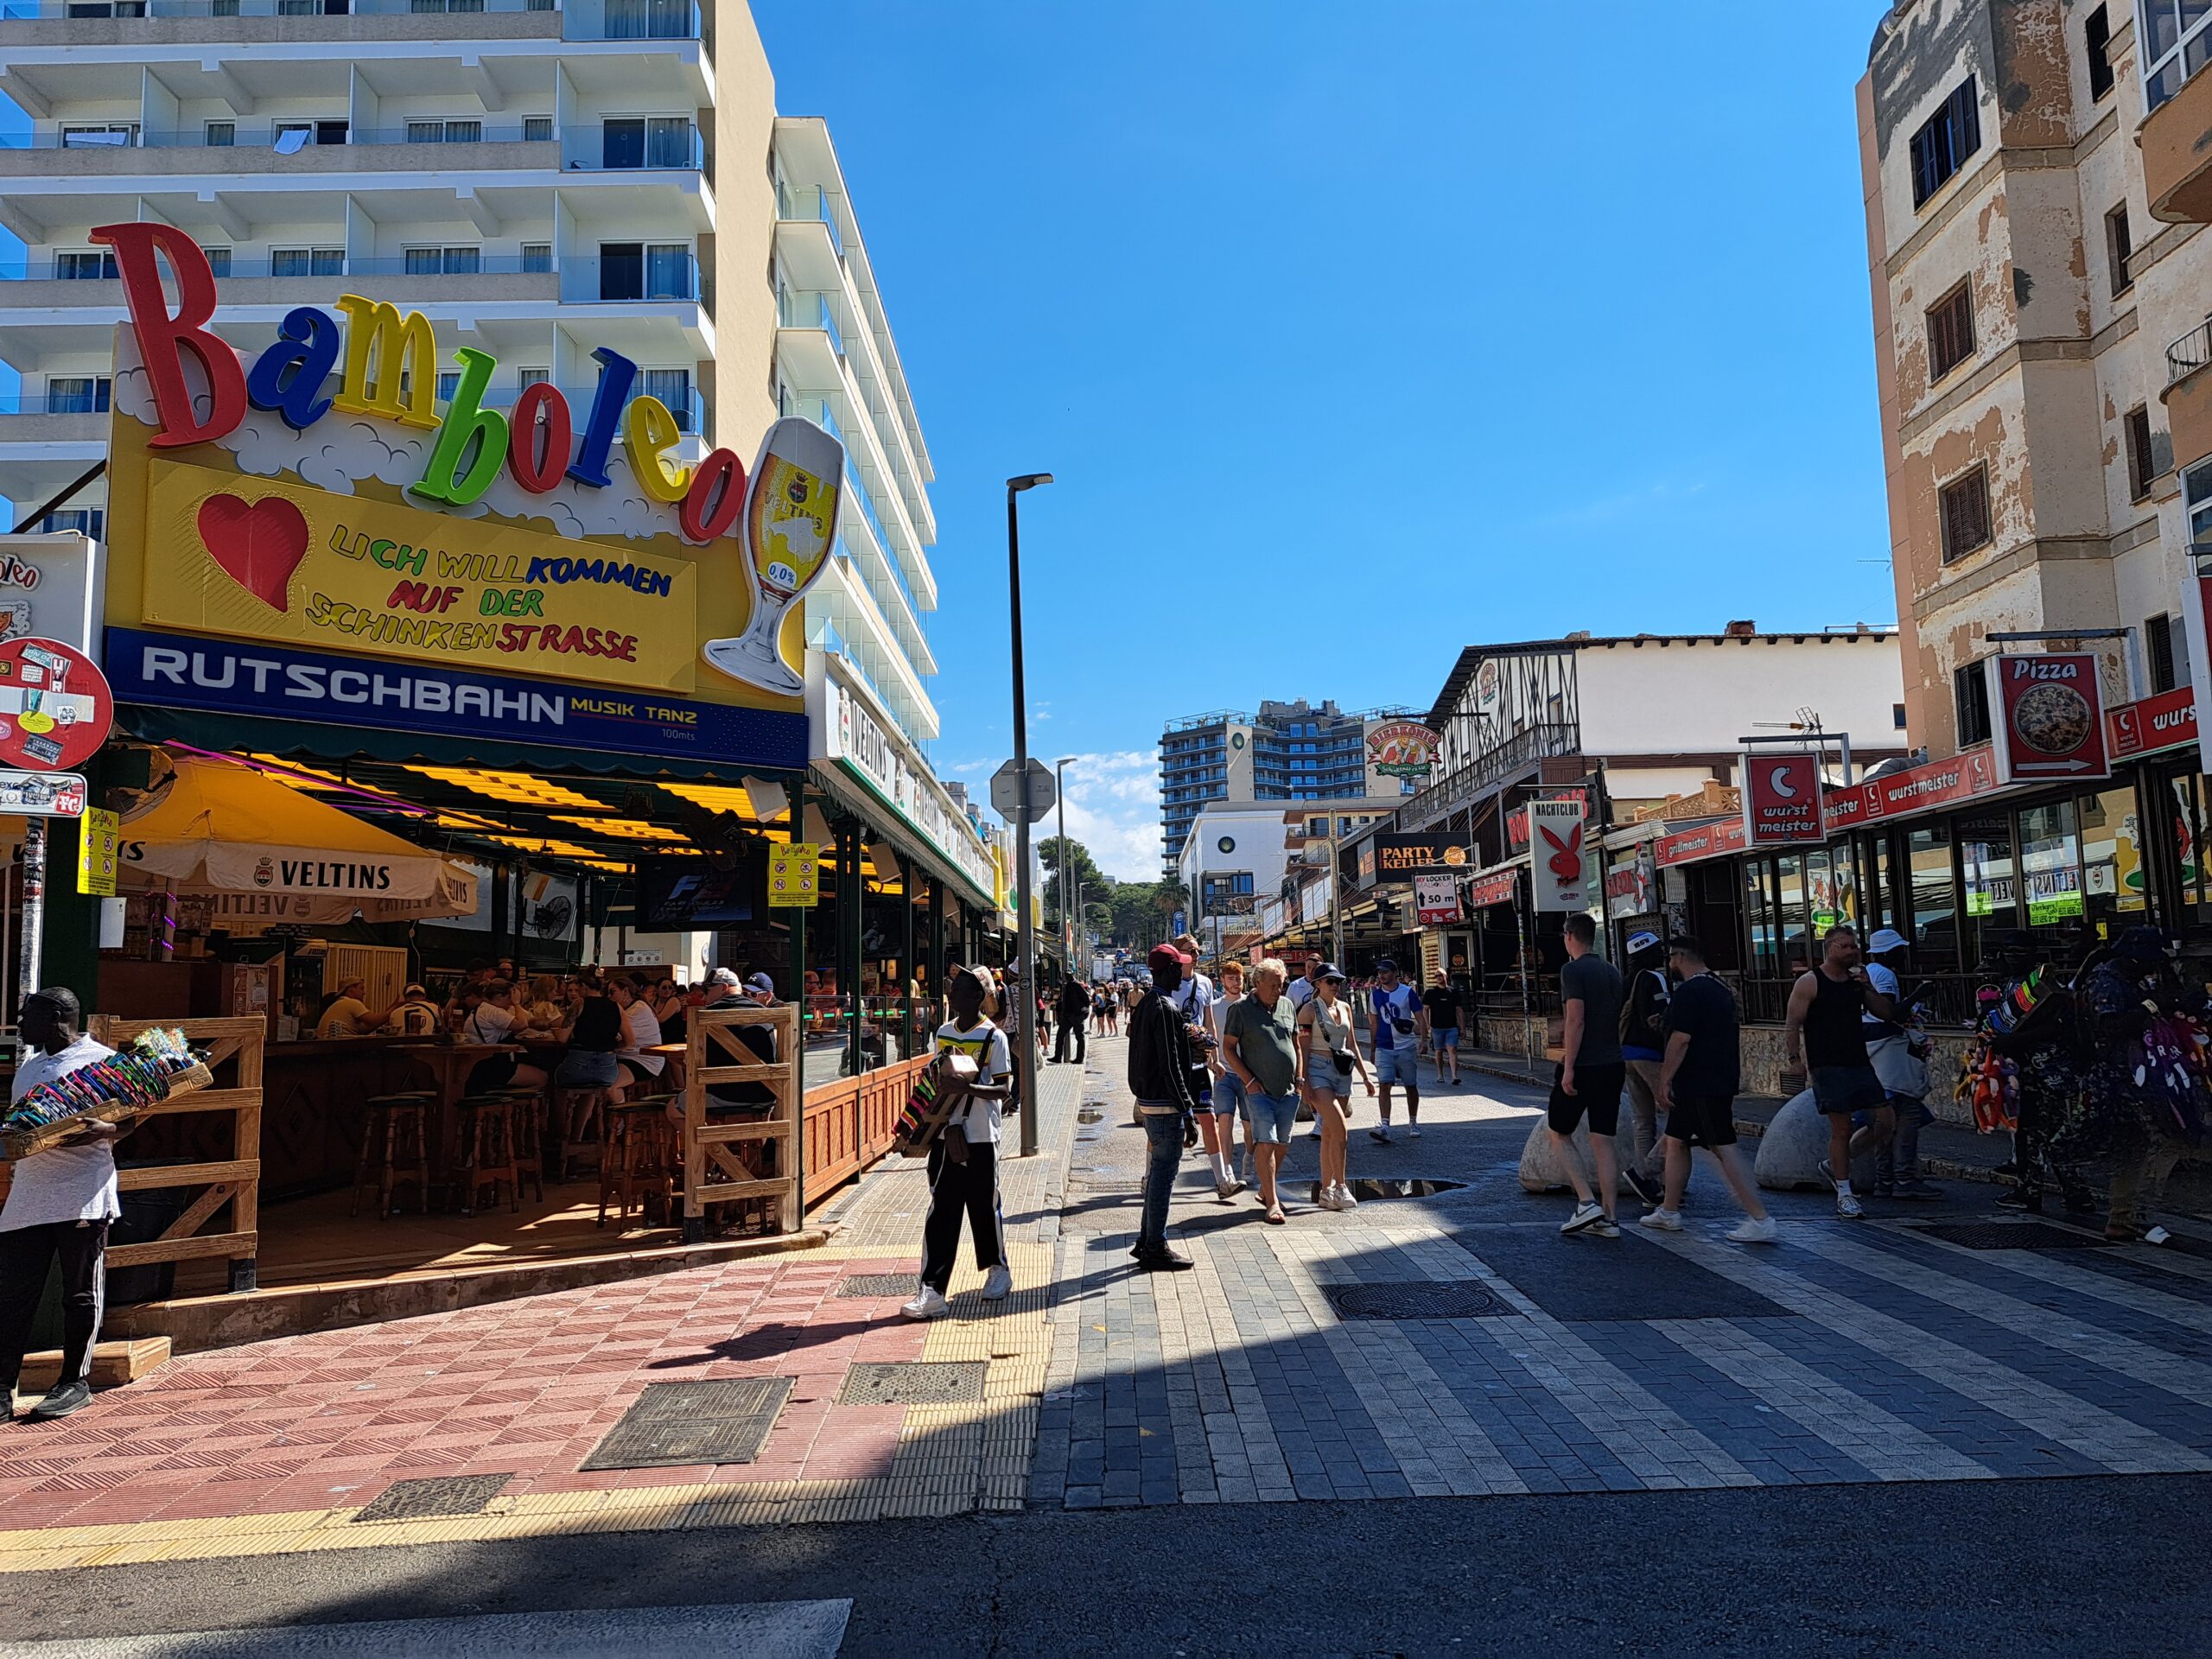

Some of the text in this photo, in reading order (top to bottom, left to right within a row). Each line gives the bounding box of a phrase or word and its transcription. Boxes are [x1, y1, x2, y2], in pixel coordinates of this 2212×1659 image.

[88, 222, 746, 543] Bamboleo
[769, 564, 795, 585] 0,0%
[387, 580, 544, 617] AUF DER
[305, 592, 639, 663] SCHINKENSTRASSE
[2013, 659, 2078, 680] Pizza
[142, 646, 698, 726] RUTSCHBAHN MUSIK TANZ
[1370, 726, 1439, 747] BIERKÖNIG
[1888, 772, 1959, 802] wurstmeister
[1535, 804, 1579, 816] NACHTCLUB
[1763, 804, 1809, 817] wurst
[1758, 820, 1816, 833] meister
[1382, 847, 1434, 858] PARTY
[1669, 836, 1708, 858] grillmeister
[1382, 858, 1434, 868] KELLER
[281, 860, 391, 890] VELTINS
